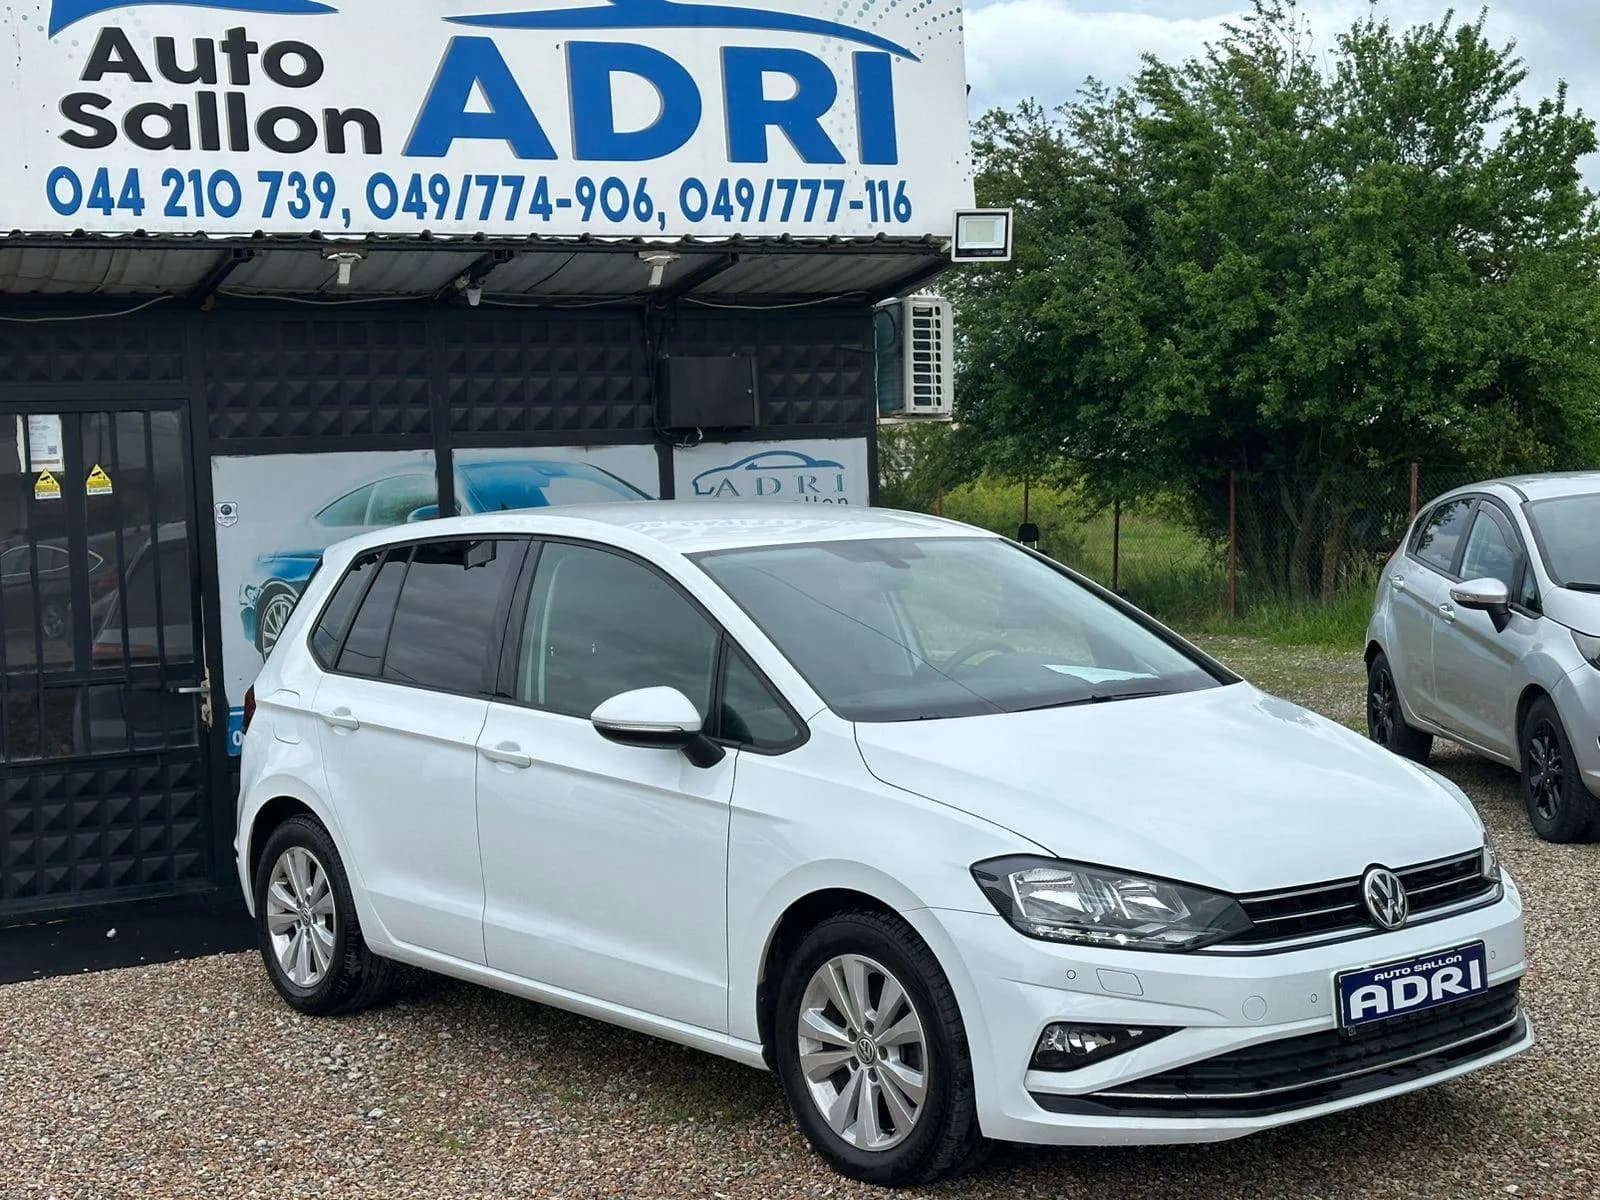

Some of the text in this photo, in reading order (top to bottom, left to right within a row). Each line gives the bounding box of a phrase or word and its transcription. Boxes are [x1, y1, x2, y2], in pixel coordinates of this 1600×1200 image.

[79, 26, 325, 88] Auto
[58, 91, 383, 154] Sallon
[401, 36, 898, 166] ADRI
[46, 166, 913, 231] 044 210 739, 049/774-906, 049/777-116
[714, 473, 846, 498] ADRI
[1349, 959, 1481, 1020] ADRI
[1374, 955, 1462, 981] AUTO SALLON
